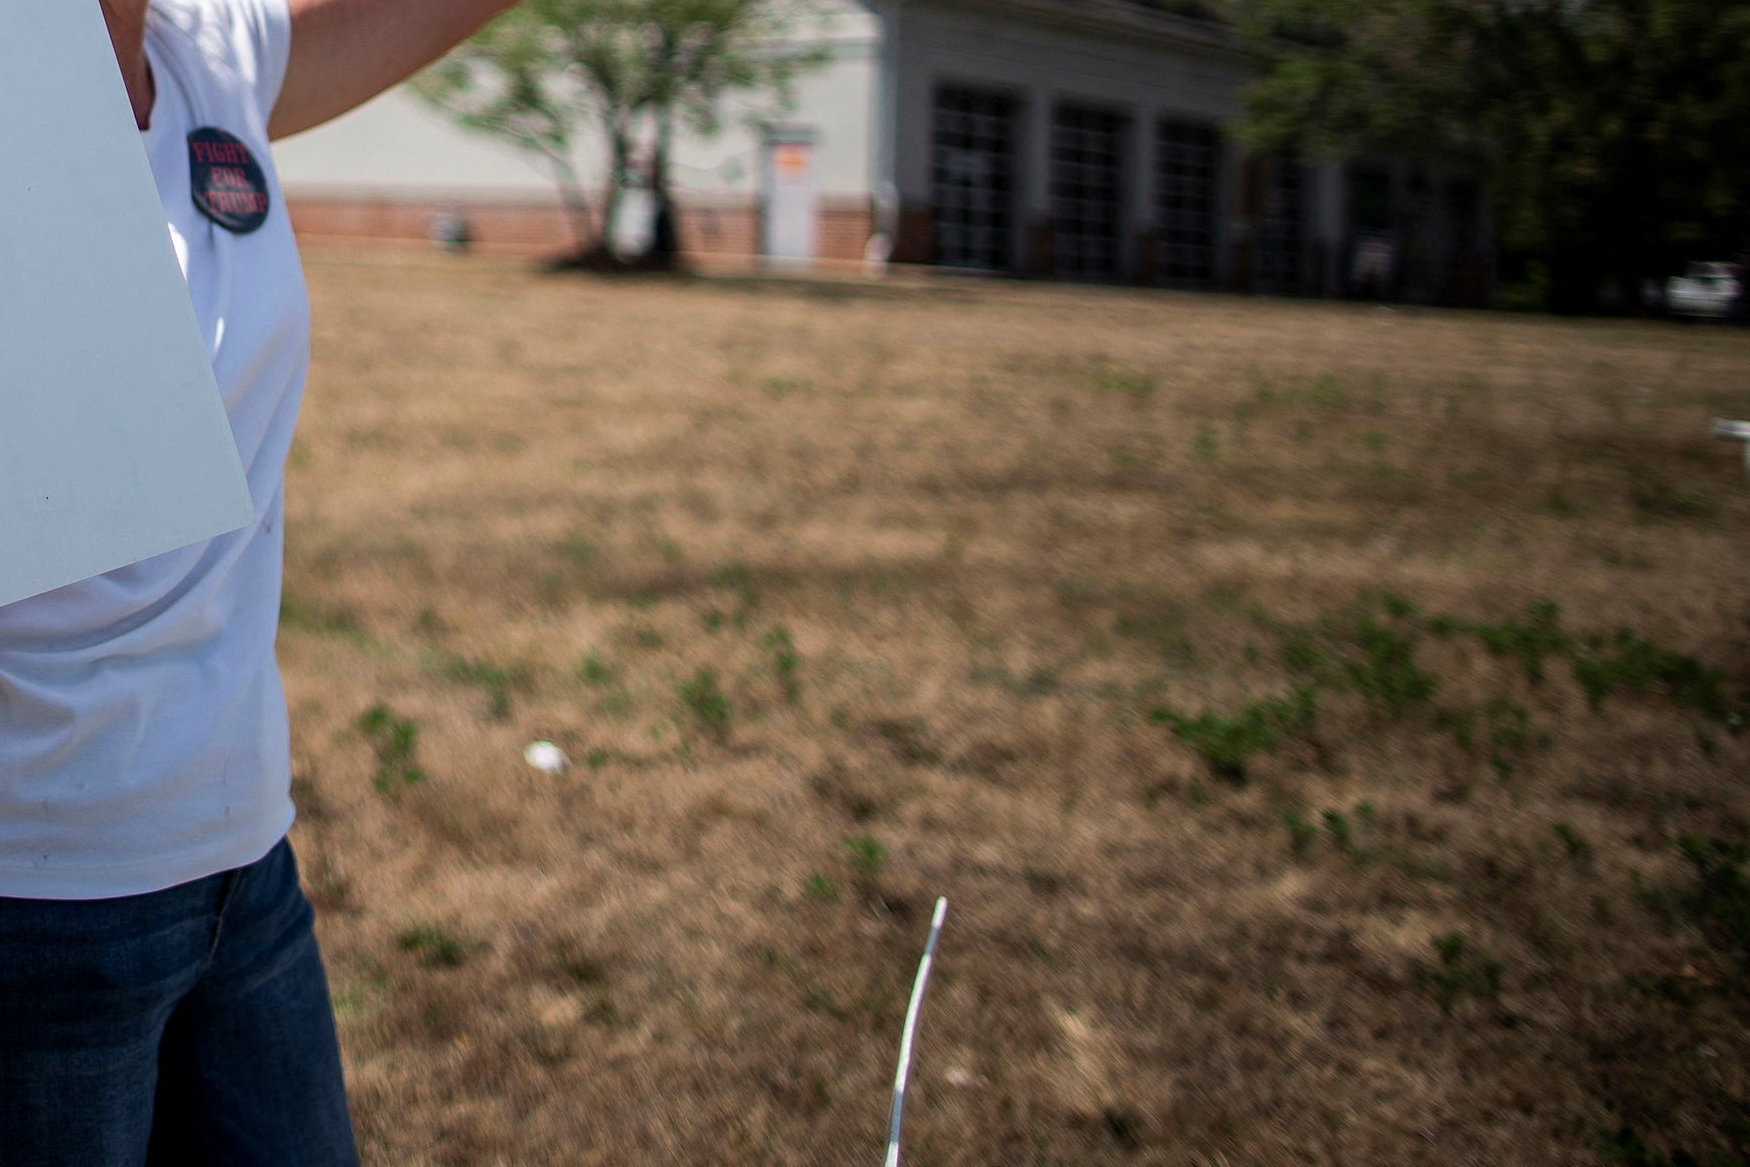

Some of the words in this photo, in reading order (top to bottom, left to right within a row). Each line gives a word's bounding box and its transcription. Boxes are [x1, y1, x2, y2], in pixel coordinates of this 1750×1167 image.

[192, 141, 249, 163] FIGHT
[209, 167, 251, 187] FOR
[203, 191, 267, 214] TRUMP
